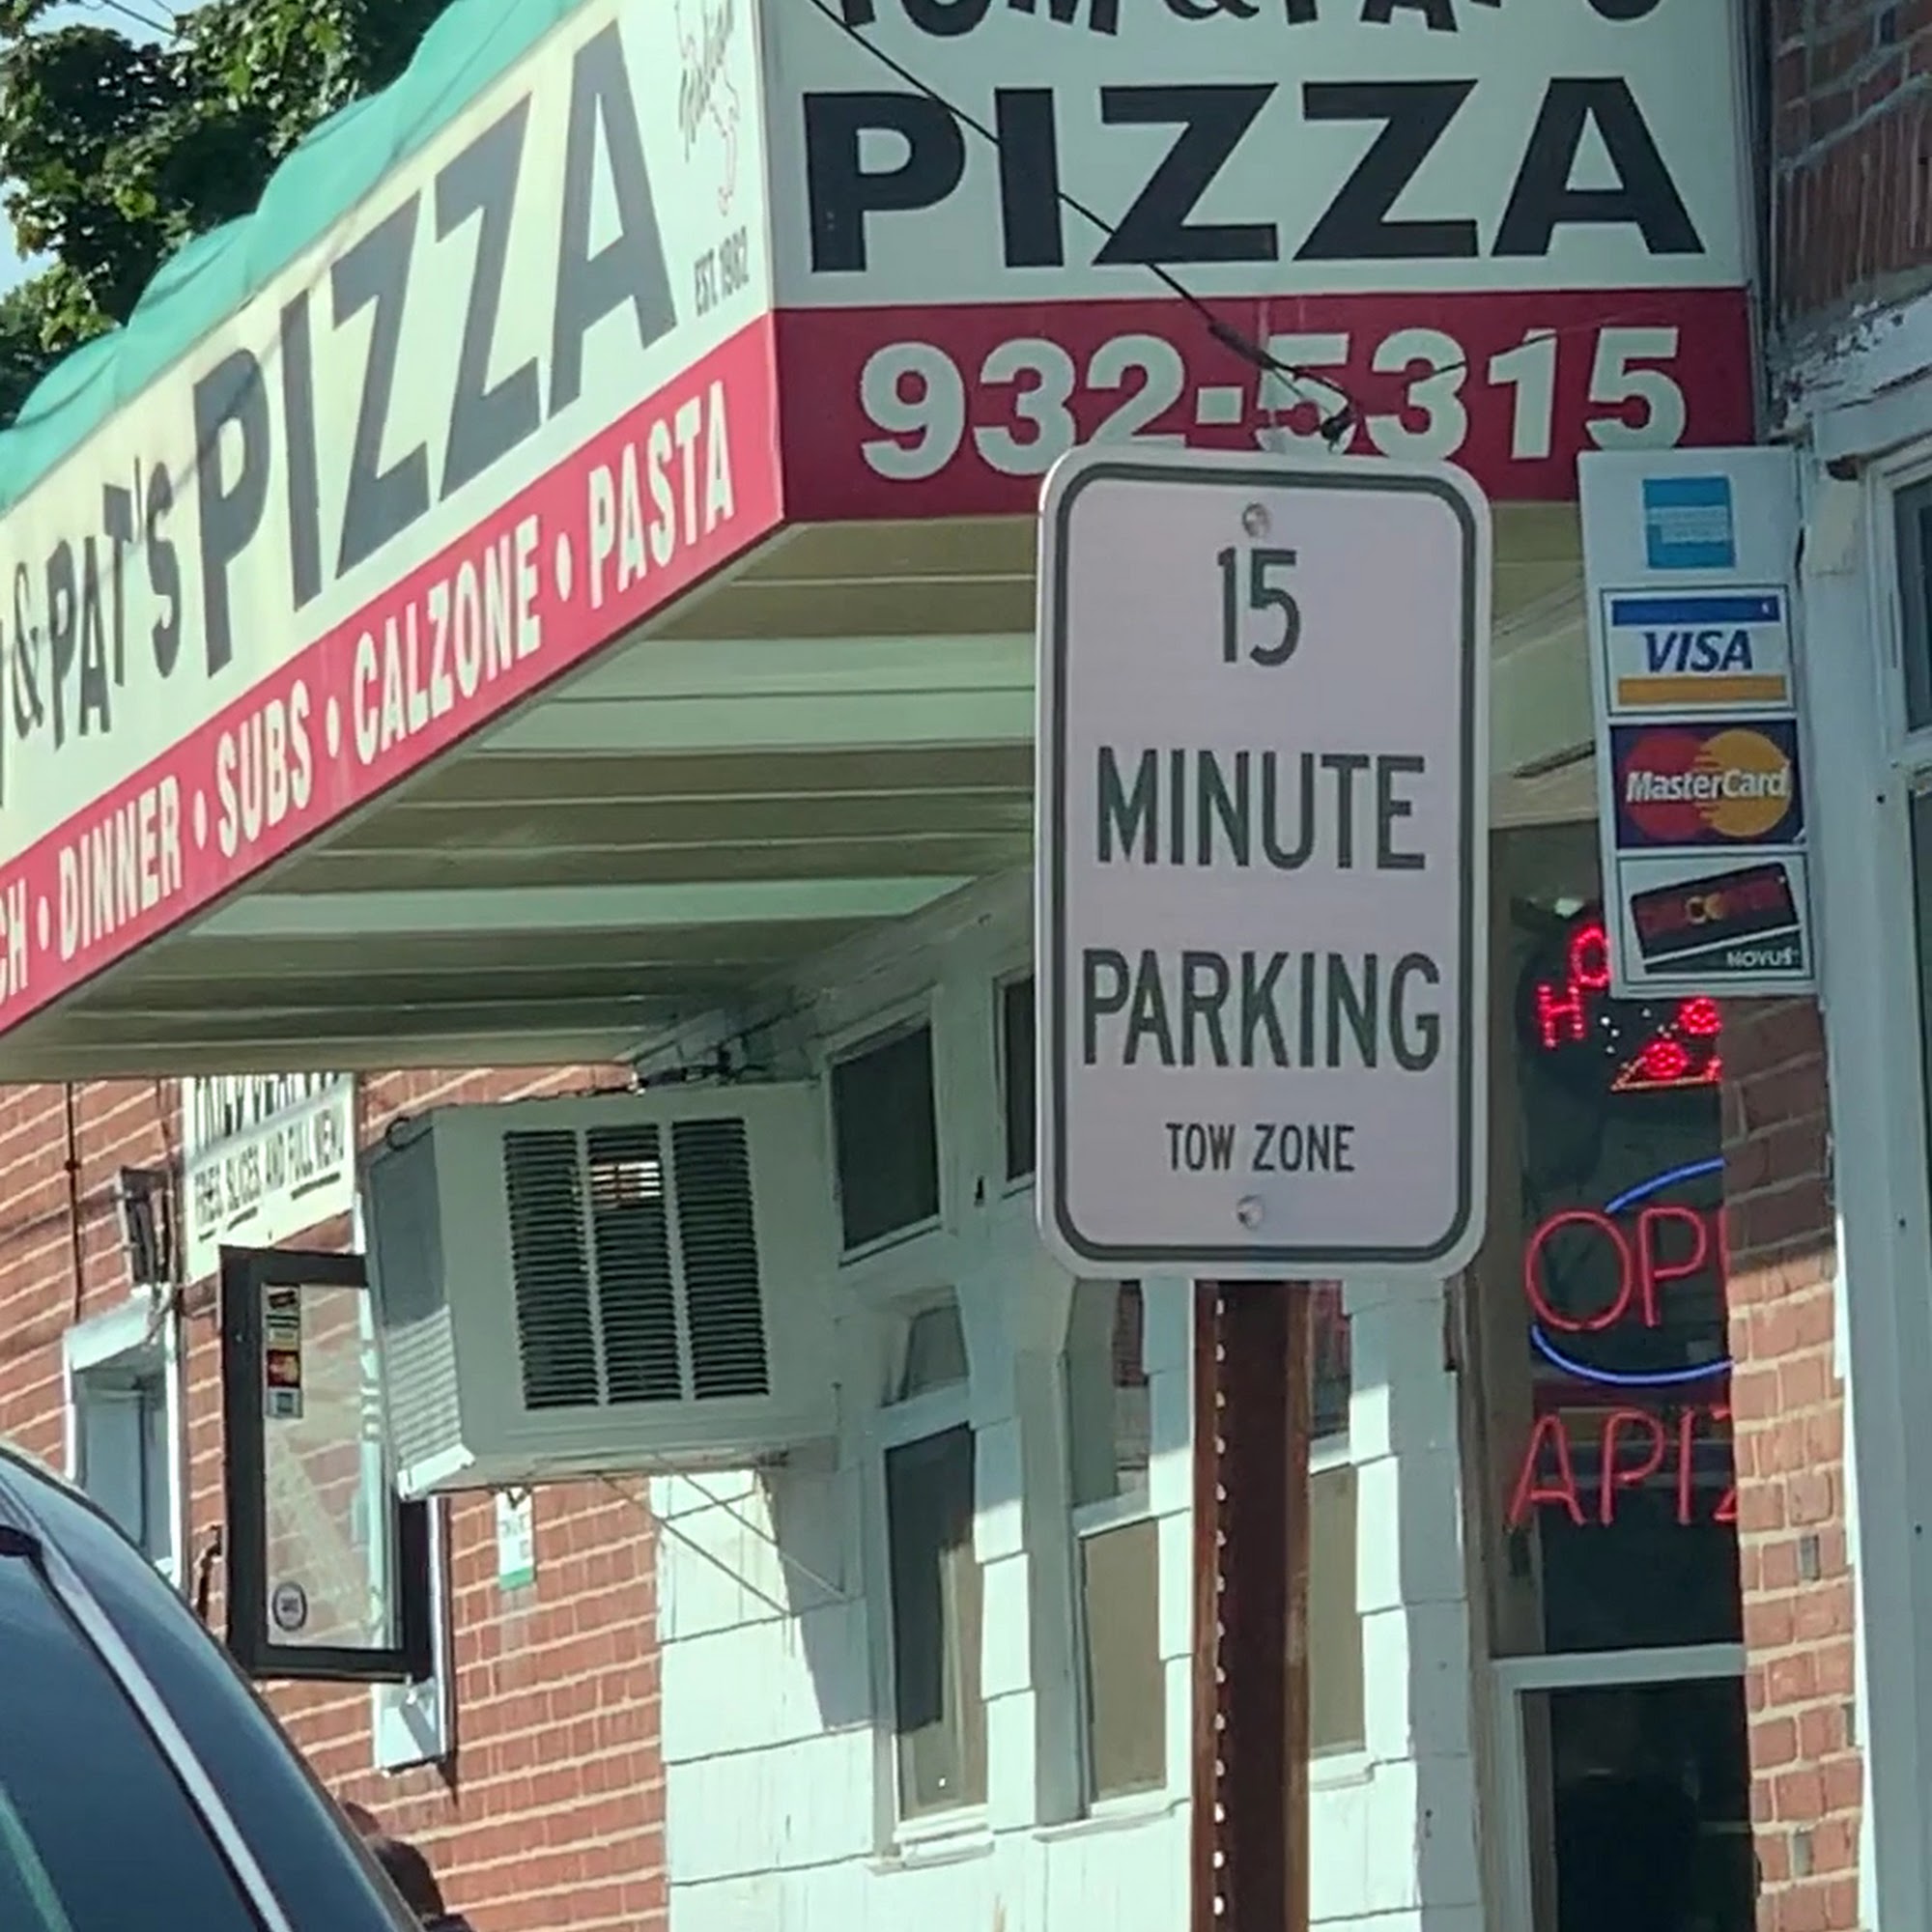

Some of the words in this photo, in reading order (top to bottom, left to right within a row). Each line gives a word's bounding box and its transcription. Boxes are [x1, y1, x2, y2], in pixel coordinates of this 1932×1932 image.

[802, 75, 1706, 273] PIZZA
[193, 18, 677, 678] PIZZA
[860, 326, 1687, 481] 932-5315
[12, 560, 44, 740] &
[45, 455, 182, 753] PAT'S
[1216, 547, 1301, 667] 15
[1642, 628, 1754, 674] VISA
[59, 775, 183, 962] DINNER
[216, 679, 312, 859] SUBS
[353, 514, 541, 765] CALZONE
[588, 381, 735, 609] PASTA
[1095, 746, 1427, 871] MINUTE
[1625, 763, 1791, 804] MasterCard
[1082, 947, 1441, 1072] PARKING
[1165, 1122, 1236, 1172] TOW
[1253, 1123, 1355, 1173] ZONE
[1525, 1207, 1729, 1331] OP
